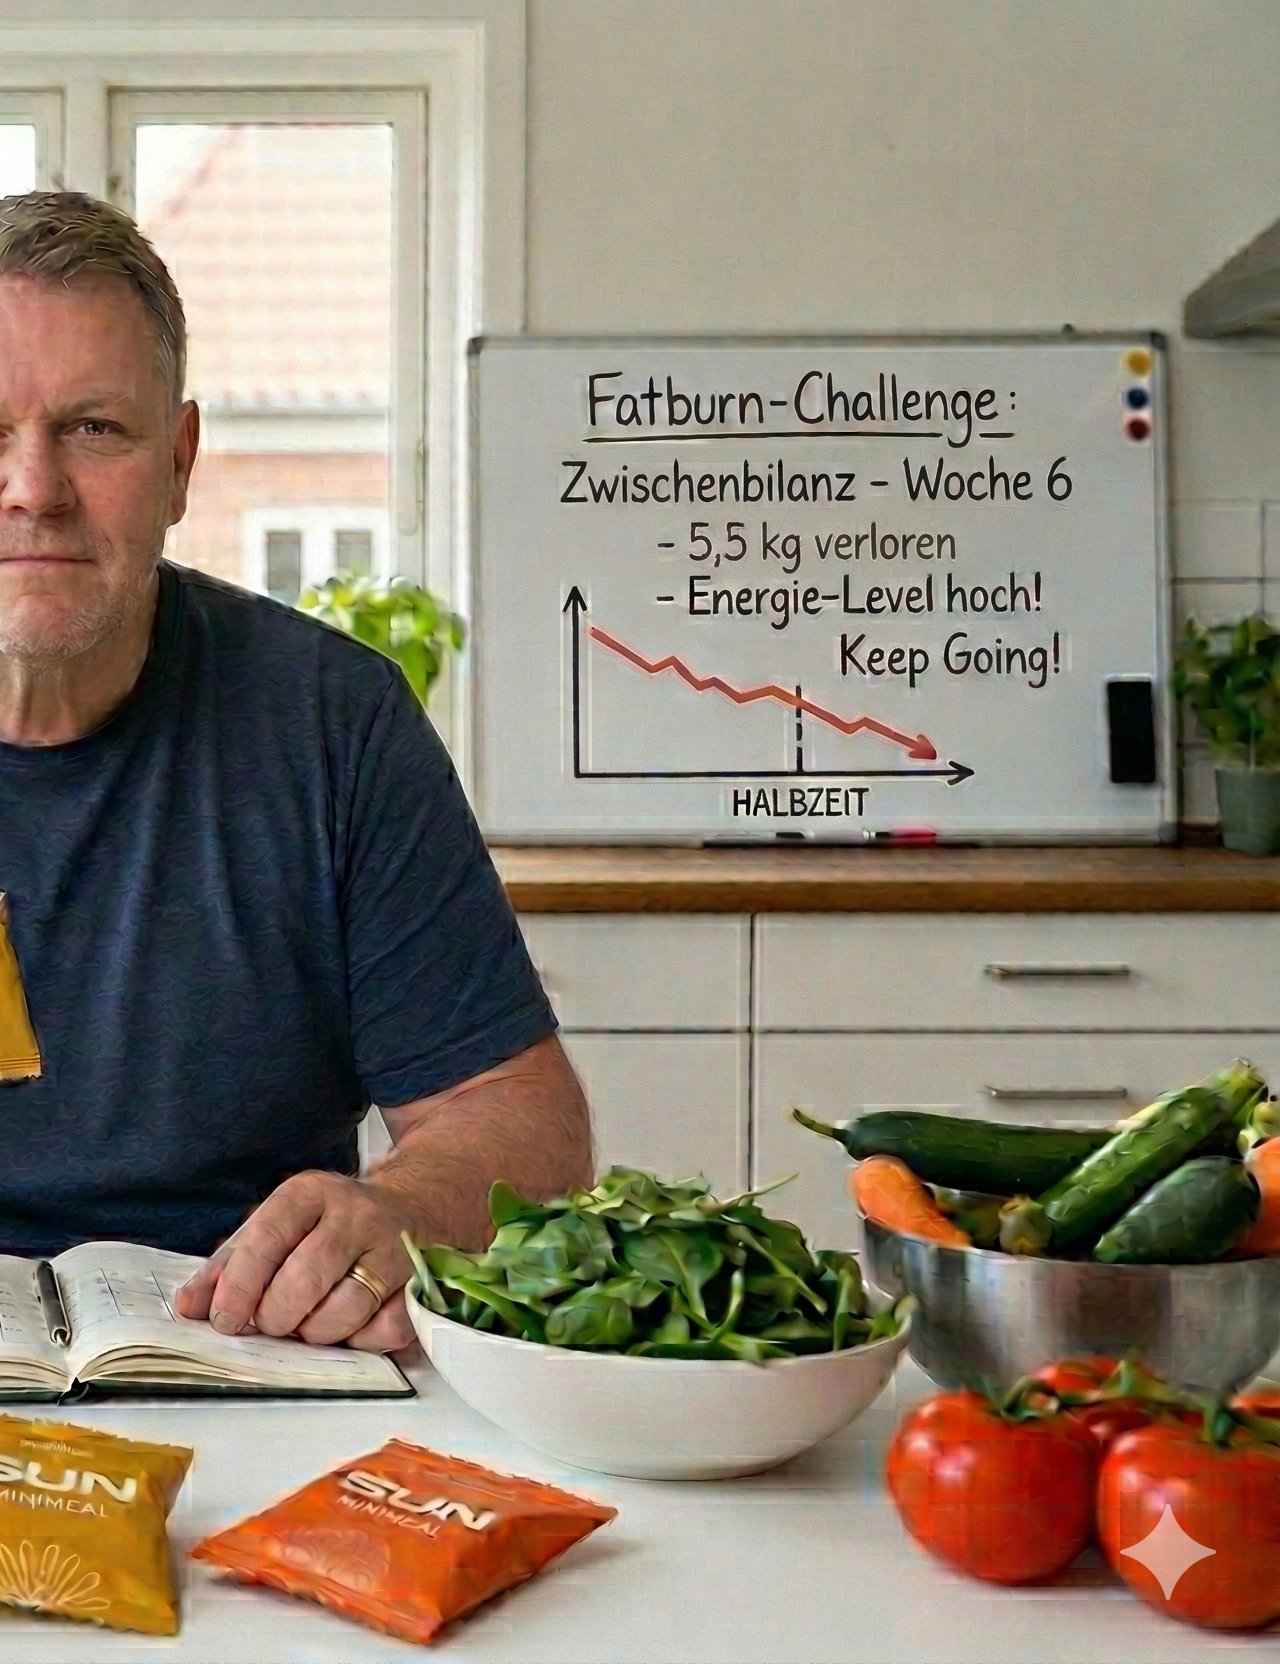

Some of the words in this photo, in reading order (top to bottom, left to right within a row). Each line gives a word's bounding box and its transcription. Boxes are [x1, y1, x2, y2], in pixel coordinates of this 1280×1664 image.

[587, 370, 1016, 449] Fatburn-Challenge:
[560, 458, 857, 504] Zwischenbilanz
[902, 454, 1034, 502] Woche
[1047, 455, 1074, 502] 6
[688, 521, 748, 568] 5,5
[761, 520, 802, 575] kg
[814, 521, 956, 561] verloren
[688, 573, 934, 631] Energie-Level
[946, 571, 1042, 614] hoch!
[840, 632, 930, 689] Keep
[943, 631, 1060, 689] Going!
[733, 787, 870, 817] HALBZEIT
[337, 1469, 498, 1531] SUN
